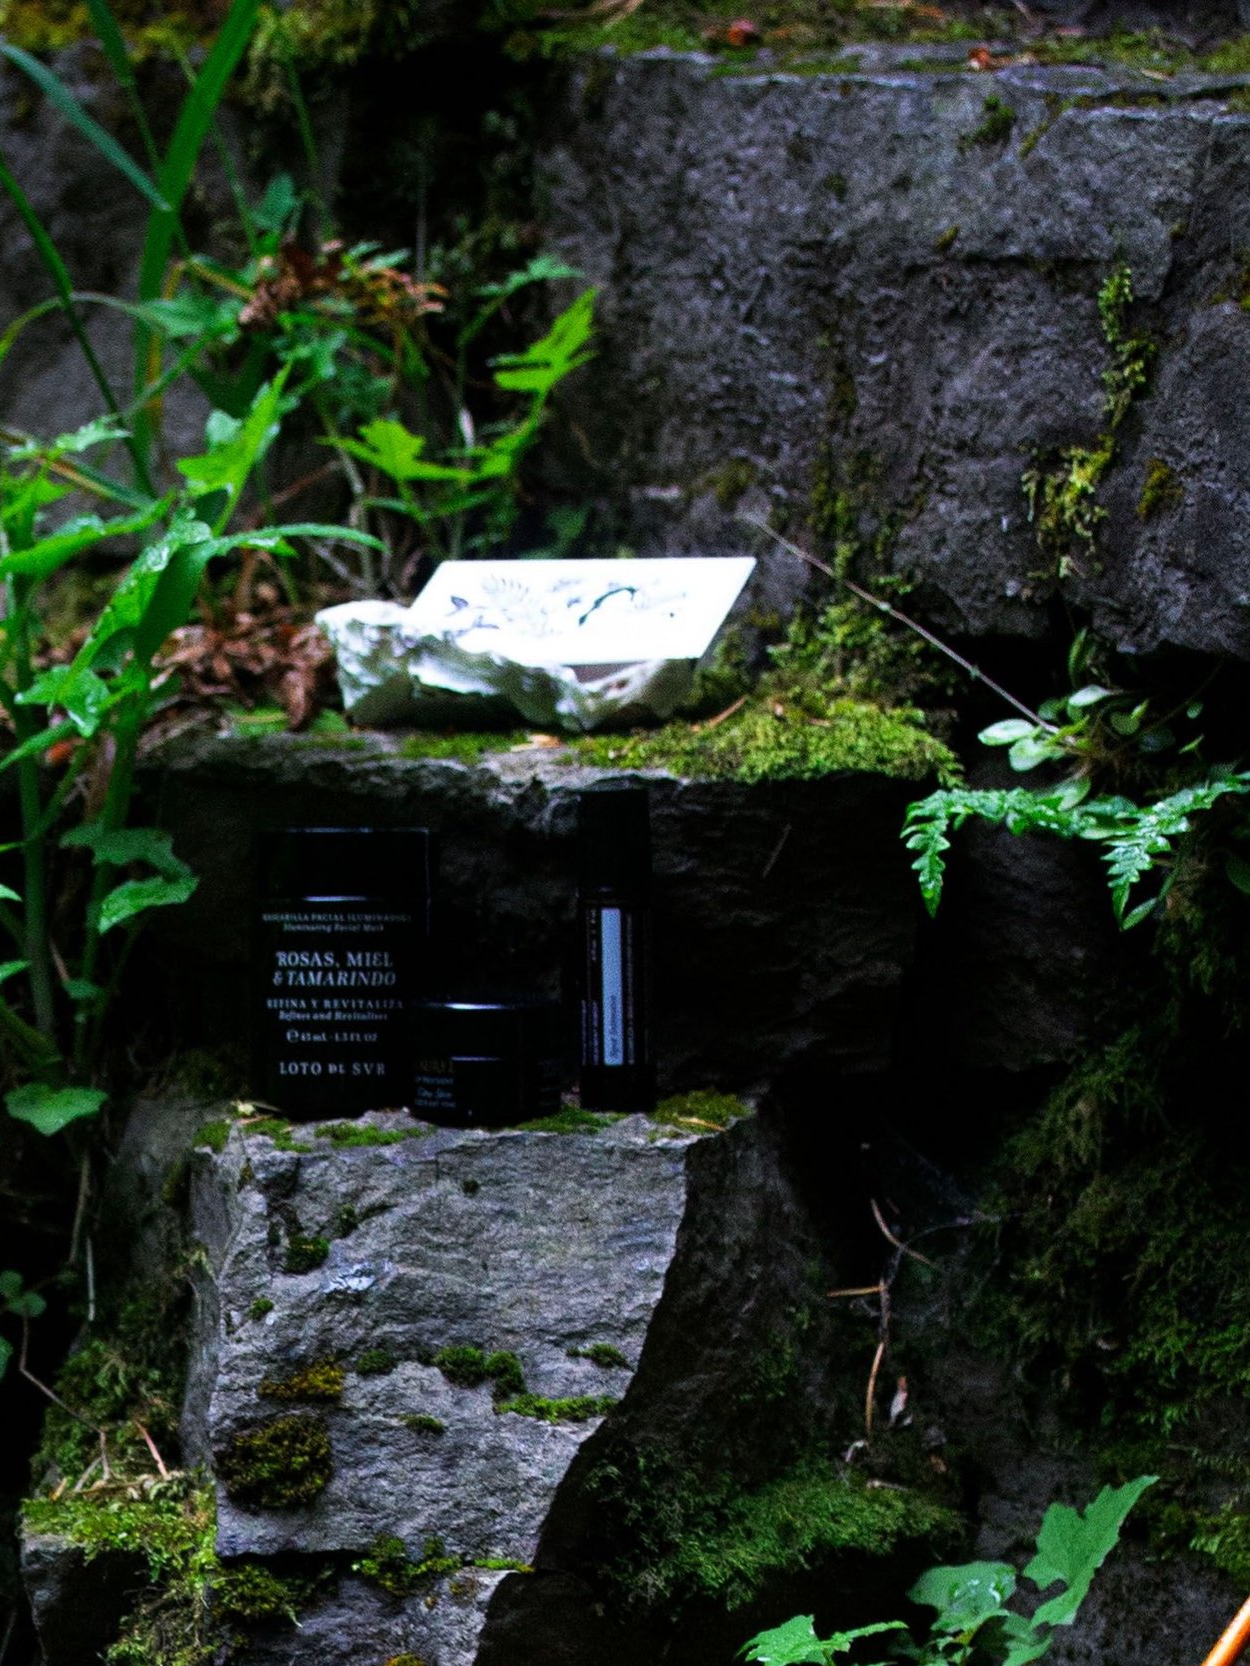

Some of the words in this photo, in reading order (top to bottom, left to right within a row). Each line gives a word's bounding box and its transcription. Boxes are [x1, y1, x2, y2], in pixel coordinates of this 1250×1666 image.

[275, 950, 340, 968] ROSAS,
[346, 950, 393, 967] MIEL
[272, 970, 283, 987] &
[285, 970, 397, 987] TAMARINDO
[279, 1061, 323, 1076] LOTO
